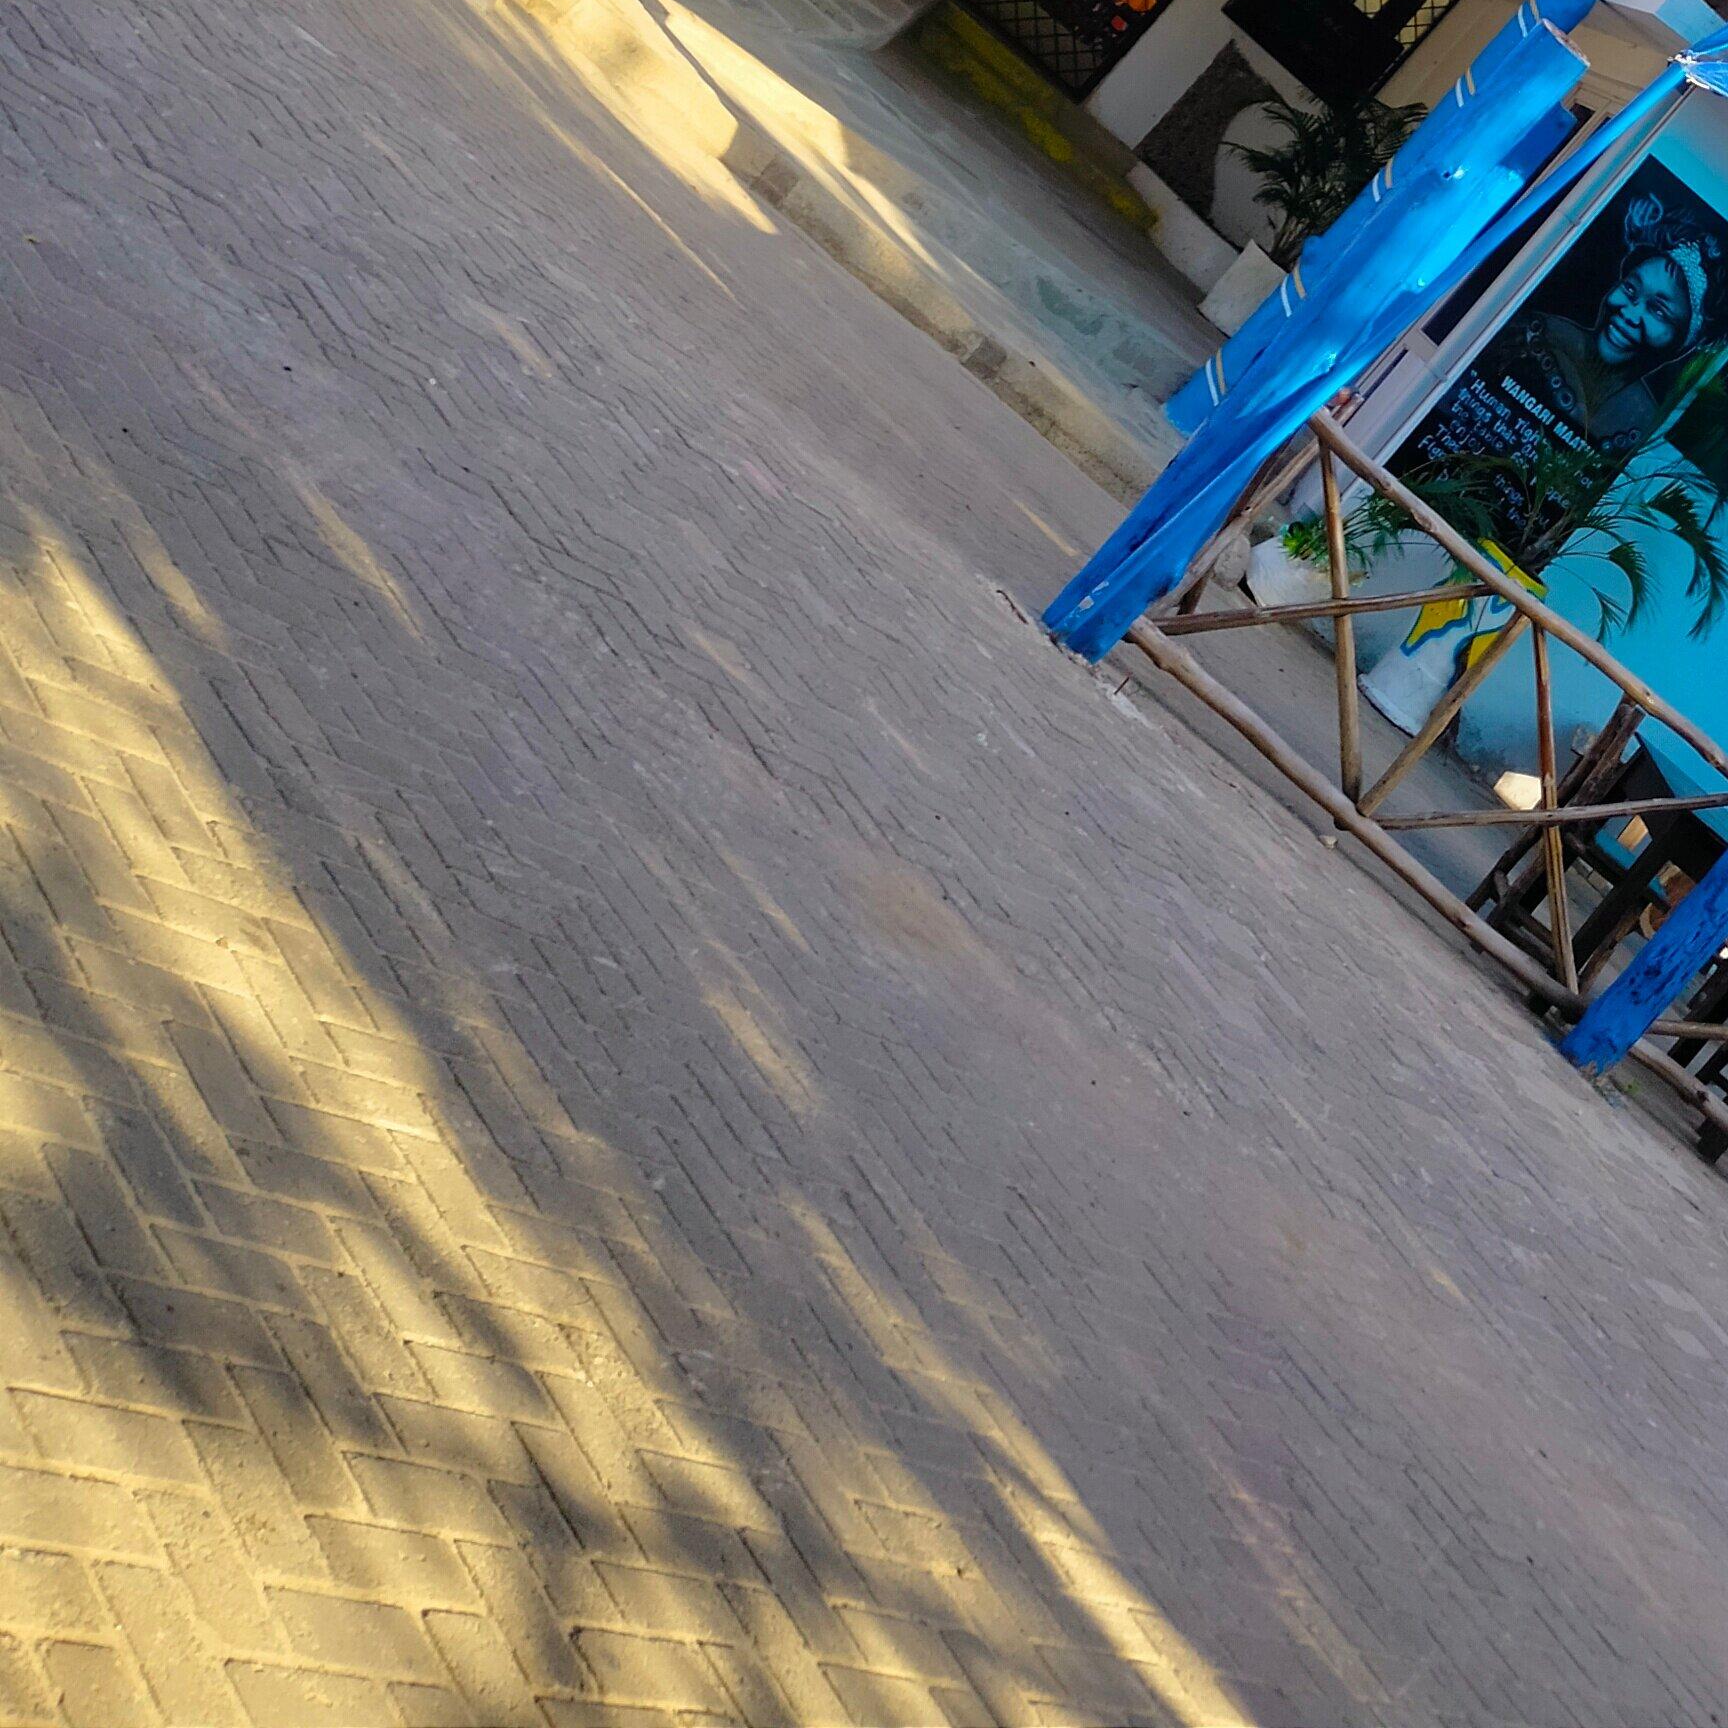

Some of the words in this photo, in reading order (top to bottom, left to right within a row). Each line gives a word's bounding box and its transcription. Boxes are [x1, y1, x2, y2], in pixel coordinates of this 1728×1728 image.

[1450, 399, 1468, 417] the
[1472, 418, 1503, 451] table
[1453, 387, 1492, 422] things
[1492, 418, 1516, 444] that
[1500, 375, 1555, 425] WANGARI
[1449, 418, 1485, 455] enjoy
